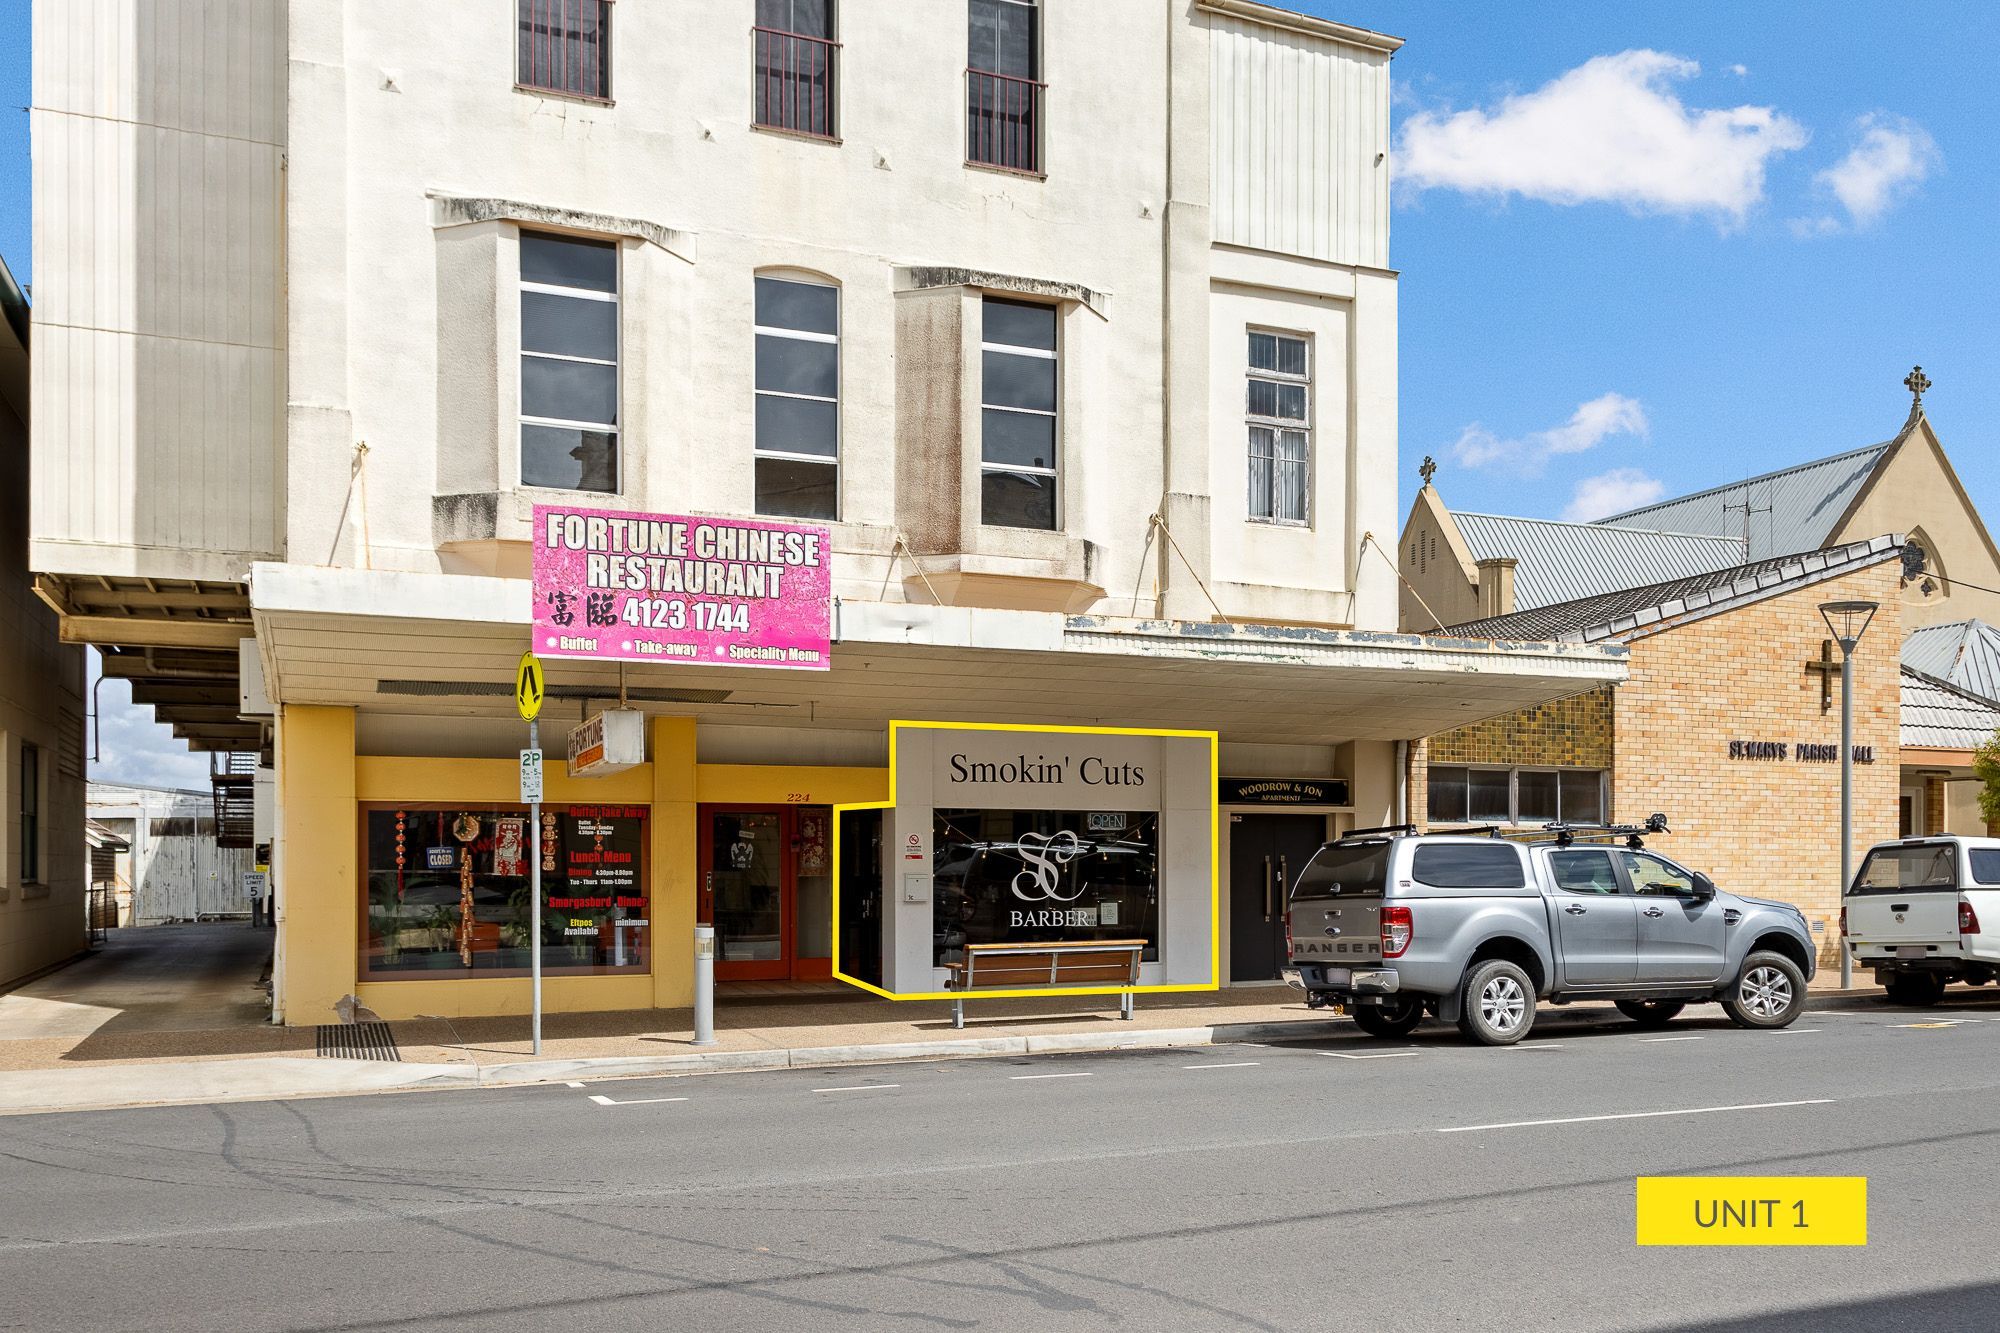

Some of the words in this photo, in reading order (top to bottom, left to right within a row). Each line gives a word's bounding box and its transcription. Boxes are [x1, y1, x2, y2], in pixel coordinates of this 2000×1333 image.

[546, 513, 688, 557] FORTUNE
[694, 524, 820, 567] CHINESE
[586, 553, 784, 599] RESTAURANT
[622, 597, 686, 630] 4123
[692, 602, 750, 633] 1744
[560, 635, 598, 651] Buffet
[634, 639, 698, 658] Take-away
[729, 644, 787, 662] Speciality
[788, 648, 820, 663] Menu
[575, 718, 603, 754] FORTUNE
[1796, 743, 1838, 761] PARISH
[1851, 745, 1875, 762] ALL
[522, 753, 541, 766] 2P
[950, 753, 1069, 783] Smokin'
[1079, 757, 1145, 786] Cuts
[1239, 782, 1292, 797] WOODROW
[1294, 784, 1301, 792] &
[1304, 785, 1323, 797] SON
[787, 793, 811, 802] 224
[601, 806, 621, 817] Take
[624, 807, 648, 818] Away
[1091, 814, 1123, 828] OPEN
[430, 854, 453, 866] CLOSED
[570, 851, 600, 863] Lunch
[603, 851, 632, 863] Menu
[250, 887, 258, 897] 5
[617, 896, 648, 908] Dinner
[570, 919, 593, 928] Eftpos
[615, 918, 649, 927] minimum
[1010, 910, 1090, 927] BARBER
[564, 927, 599, 936] Available
[1294, 943, 1380, 953] RANGER
